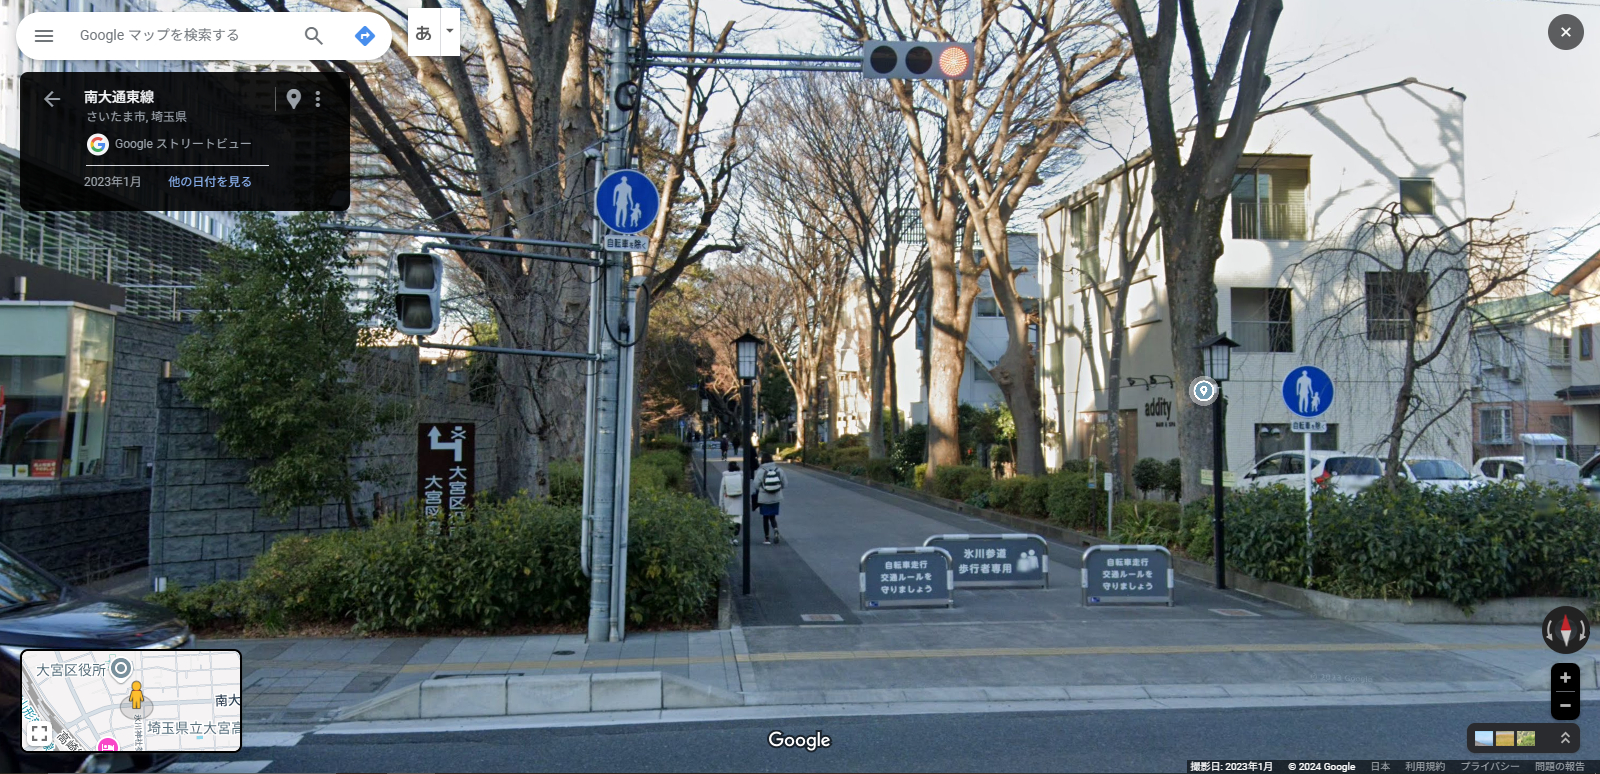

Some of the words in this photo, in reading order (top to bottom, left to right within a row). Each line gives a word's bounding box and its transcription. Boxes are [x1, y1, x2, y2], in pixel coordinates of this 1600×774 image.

[607, 238, 647, 250] 自転車を除く
[1144, 397, 1172, 421] addity
[964, 548, 1007, 559] 氷川参道
[885, 560, 928, 570] 自転車走行
[1107, 558, 1149, 567] 自転車走行
[958, 563, 1012, 574] 歩行者専用
[880, 572, 933, 582] 交通ルールを
[1102, 570, 1153, 579] 交通ルールを
[880, 584, 933, 595] 守りましょう
[1102, 581, 1153, 591] 守りましょう
